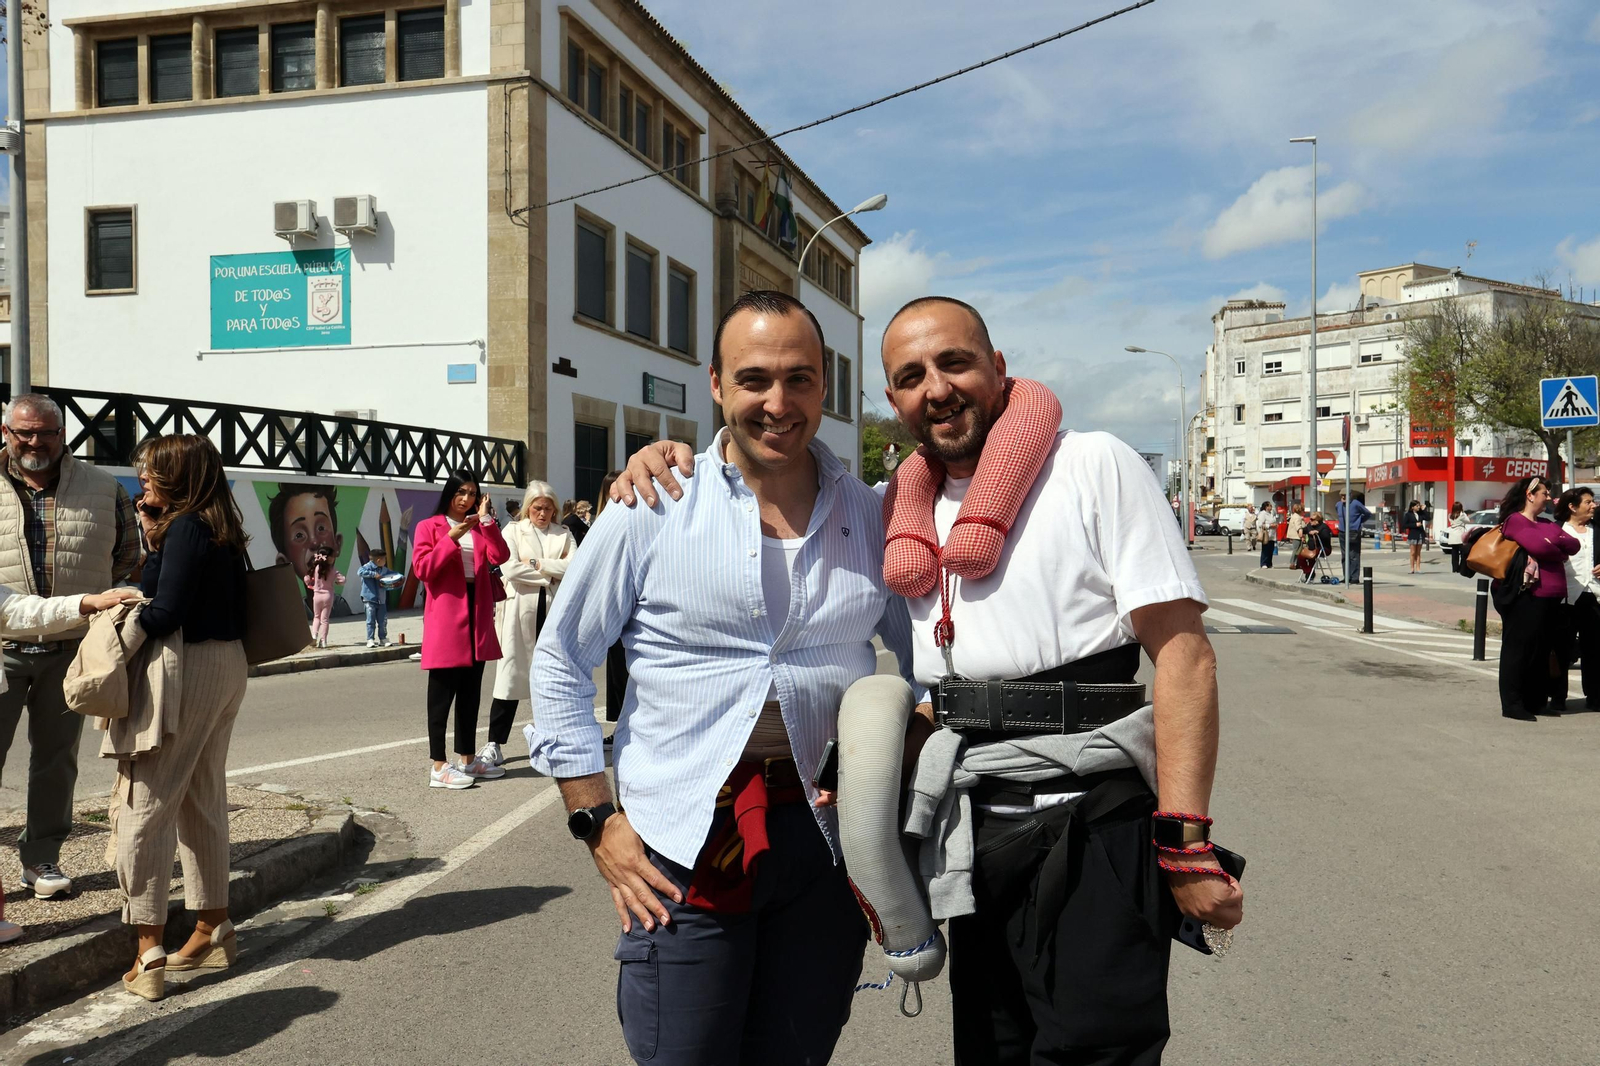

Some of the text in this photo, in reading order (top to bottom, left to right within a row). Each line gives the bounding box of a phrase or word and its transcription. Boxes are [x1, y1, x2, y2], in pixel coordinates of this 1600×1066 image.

[215, 266, 238, 279] POR
[238, 265, 258, 277] UNA
[259, 263, 302, 276] ESCUELA
[235, 288, 291, 303] DE TOD@S
[259, 303, 268, 317] Y
[226, 316, 300, 333] PARA TOD@S
[1374, 465, 1387, 482] CEPSA
[1506, 460, 1547, 477] CEPSA
